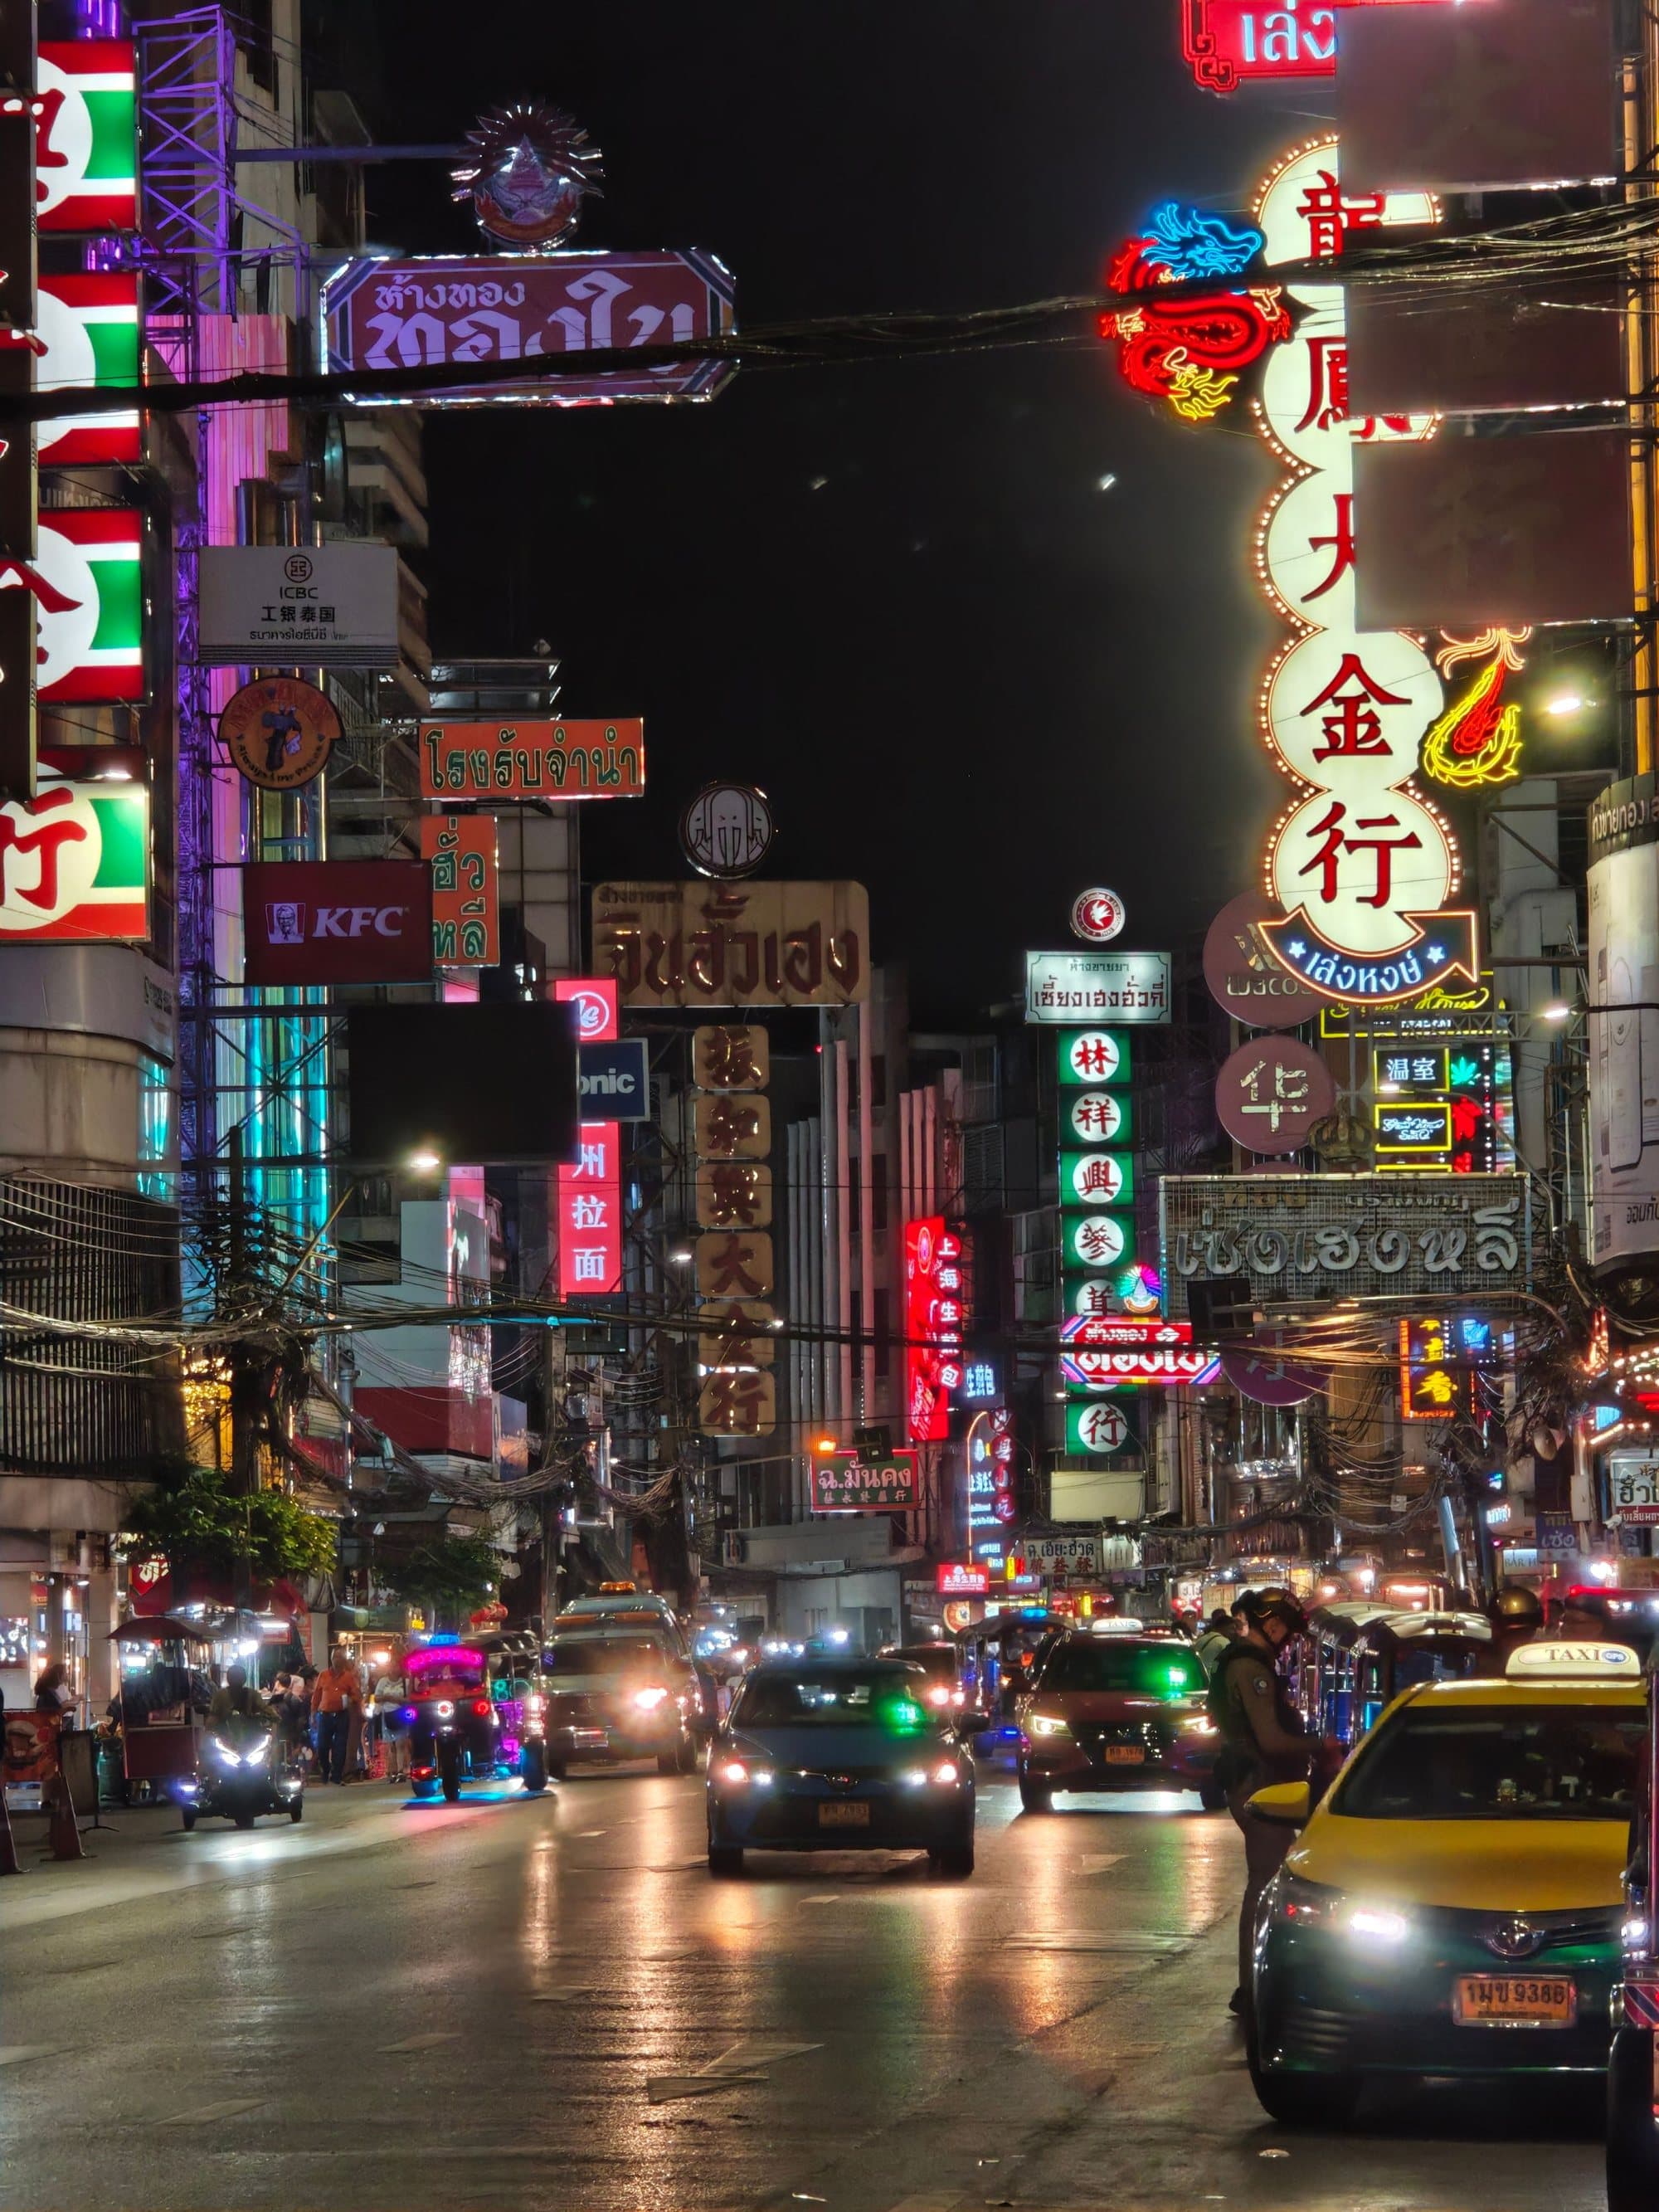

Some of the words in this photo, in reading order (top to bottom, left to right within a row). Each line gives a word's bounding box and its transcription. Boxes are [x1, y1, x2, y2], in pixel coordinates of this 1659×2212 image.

[376, 275, 525, 310] ห้างทอง
[280, 586, 319, 599] ICBC
[425, 725, 639, 790] โรงรับจำนำ
[312, 906, 402, 938] KFC
[1305, 950, 1423, 992] เล่งหงษ์
[1386, 1058, 1437, 1081] 温室
[1546, 1649, 1600, 1661] TAXI
